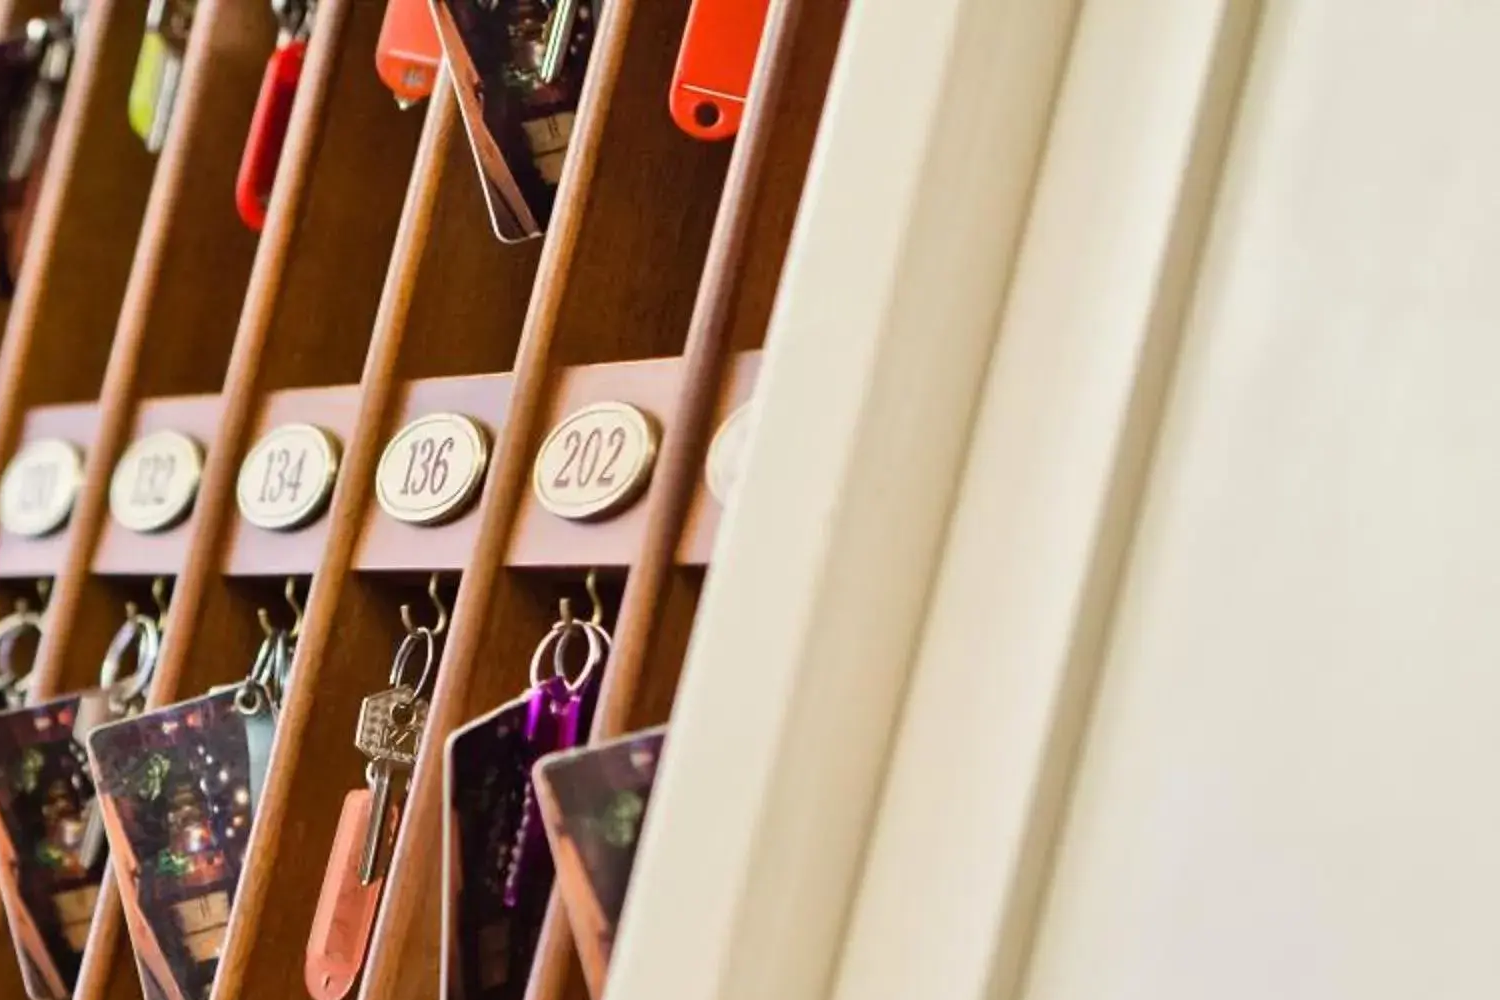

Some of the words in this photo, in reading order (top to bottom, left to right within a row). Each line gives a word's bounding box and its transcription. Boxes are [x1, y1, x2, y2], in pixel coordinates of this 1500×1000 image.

[257, 448, 307, 503] 134
[400, 437, 455, 496] 136
[553, 426, 626, 489] 202
